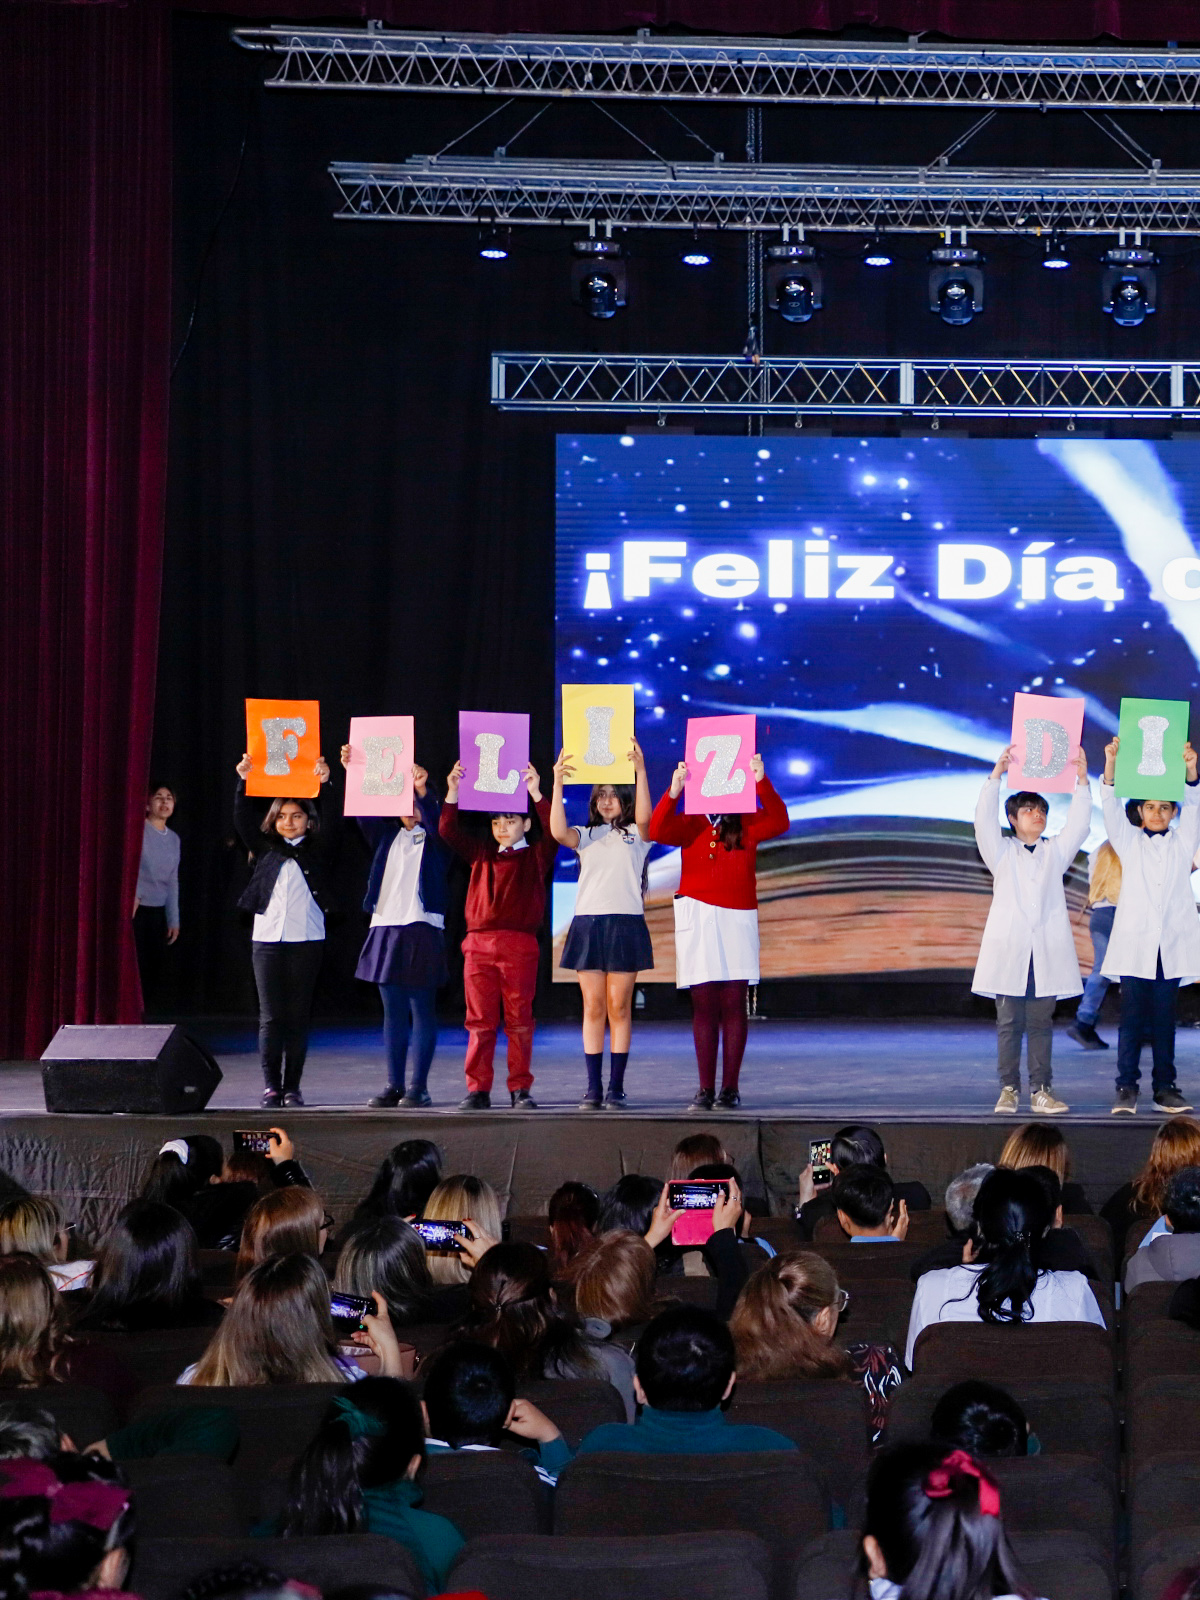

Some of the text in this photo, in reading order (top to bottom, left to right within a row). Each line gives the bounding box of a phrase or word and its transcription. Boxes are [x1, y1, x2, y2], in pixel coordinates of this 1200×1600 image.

[584, 540, 895, 609] ¡Feliz
[938, 541, 1124, 601] Día
[262, 717, 306, 775] F
[362, 736, 404, 796] E
[474, 733, 520, 795] L
[584, 706, 616, 766] I
[695, 735, 746, 797] Z
[1022, 718, 1070, 778] D
[1137, 715, 1170, 776] I
